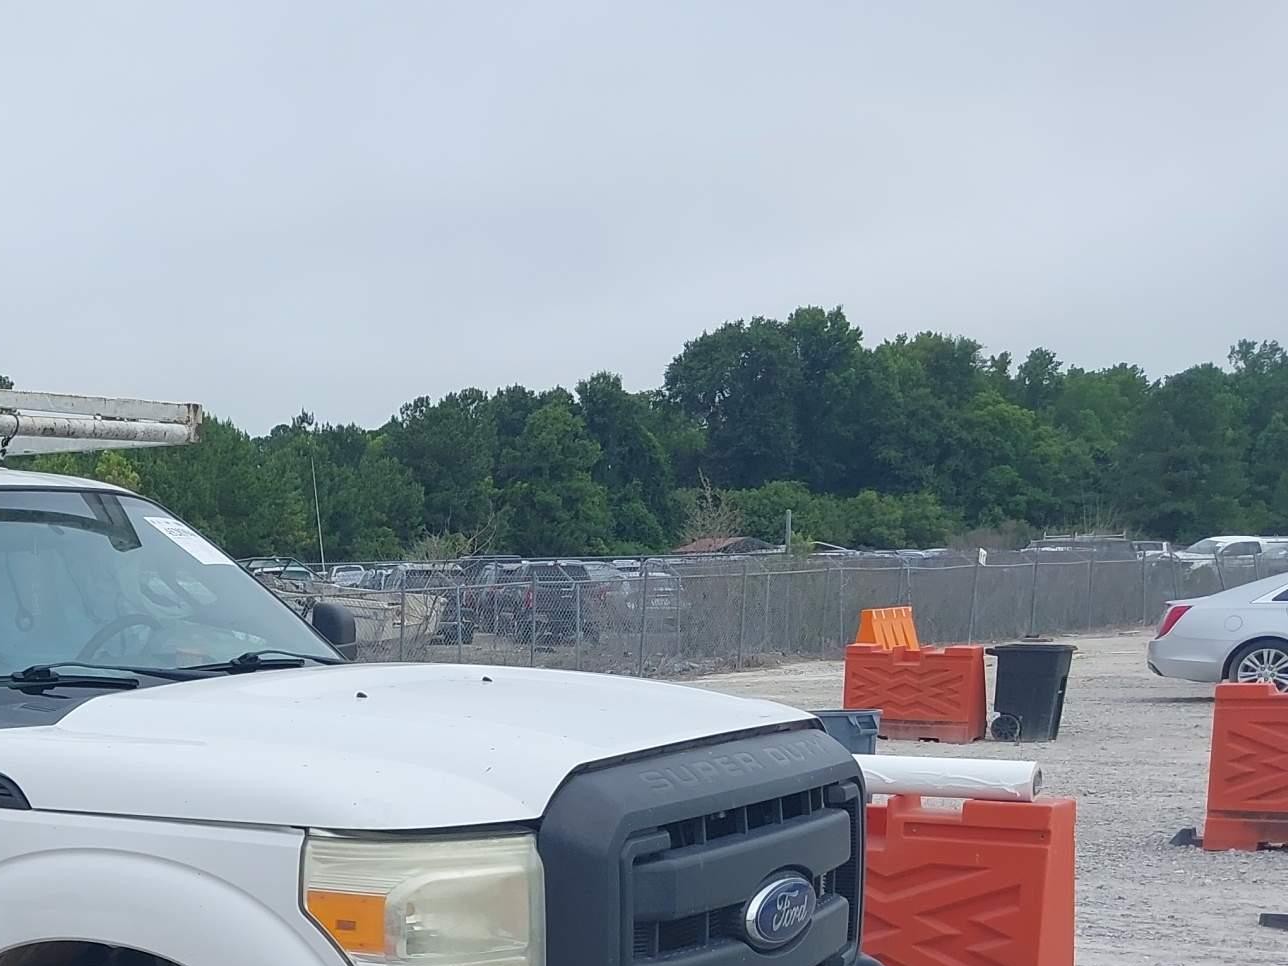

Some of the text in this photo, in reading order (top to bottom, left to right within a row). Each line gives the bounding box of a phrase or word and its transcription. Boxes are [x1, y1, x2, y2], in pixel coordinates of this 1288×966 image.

[640, 737, 828, 791] SUPER DUTY
[772, 890, 809, 931] Ford
